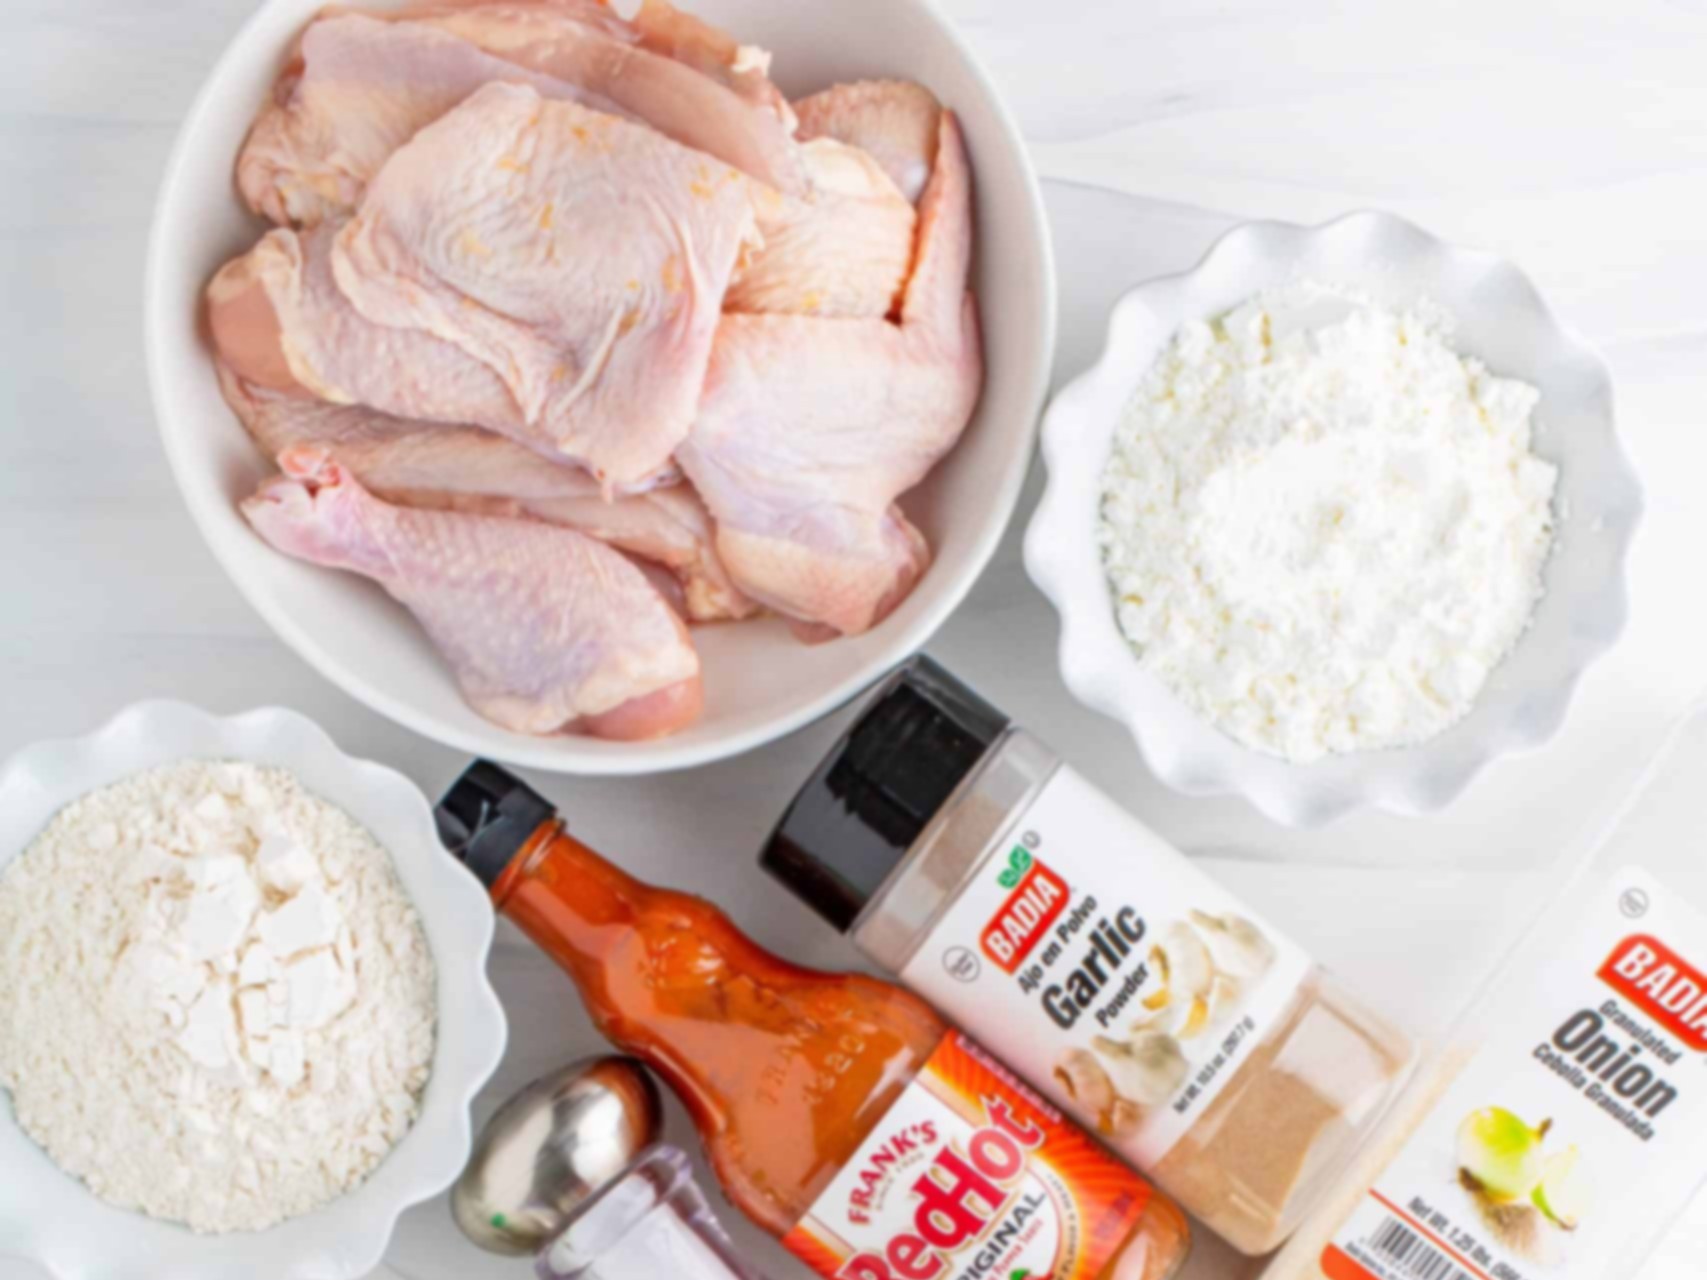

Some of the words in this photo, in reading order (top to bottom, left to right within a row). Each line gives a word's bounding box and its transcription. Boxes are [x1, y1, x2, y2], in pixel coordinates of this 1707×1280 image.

[986, 874, 1061, 962] BADIA
[1017, 964, 1044, 994] Ajo
[1041, 942, 1062, 966] en
[1055, 895, 1097, 943] Polvo
[1039, 904, 1147, 1030] Garlic
[1094, 963, 1148, 1028] Powder
[1596, 999, 1683, 1066] Granulated
[1532, 1042, 1587, 1089] Cebolla
[1583, 1082, 1655, 1141] Granulada
[1550, 1006, 1680, 1119] Onion
[847, 1120, 938, 1225] FRANK'S
[1408, 1196, 1432, 1219] Net
[1448, 1227, 1475, 1251] 1.25
